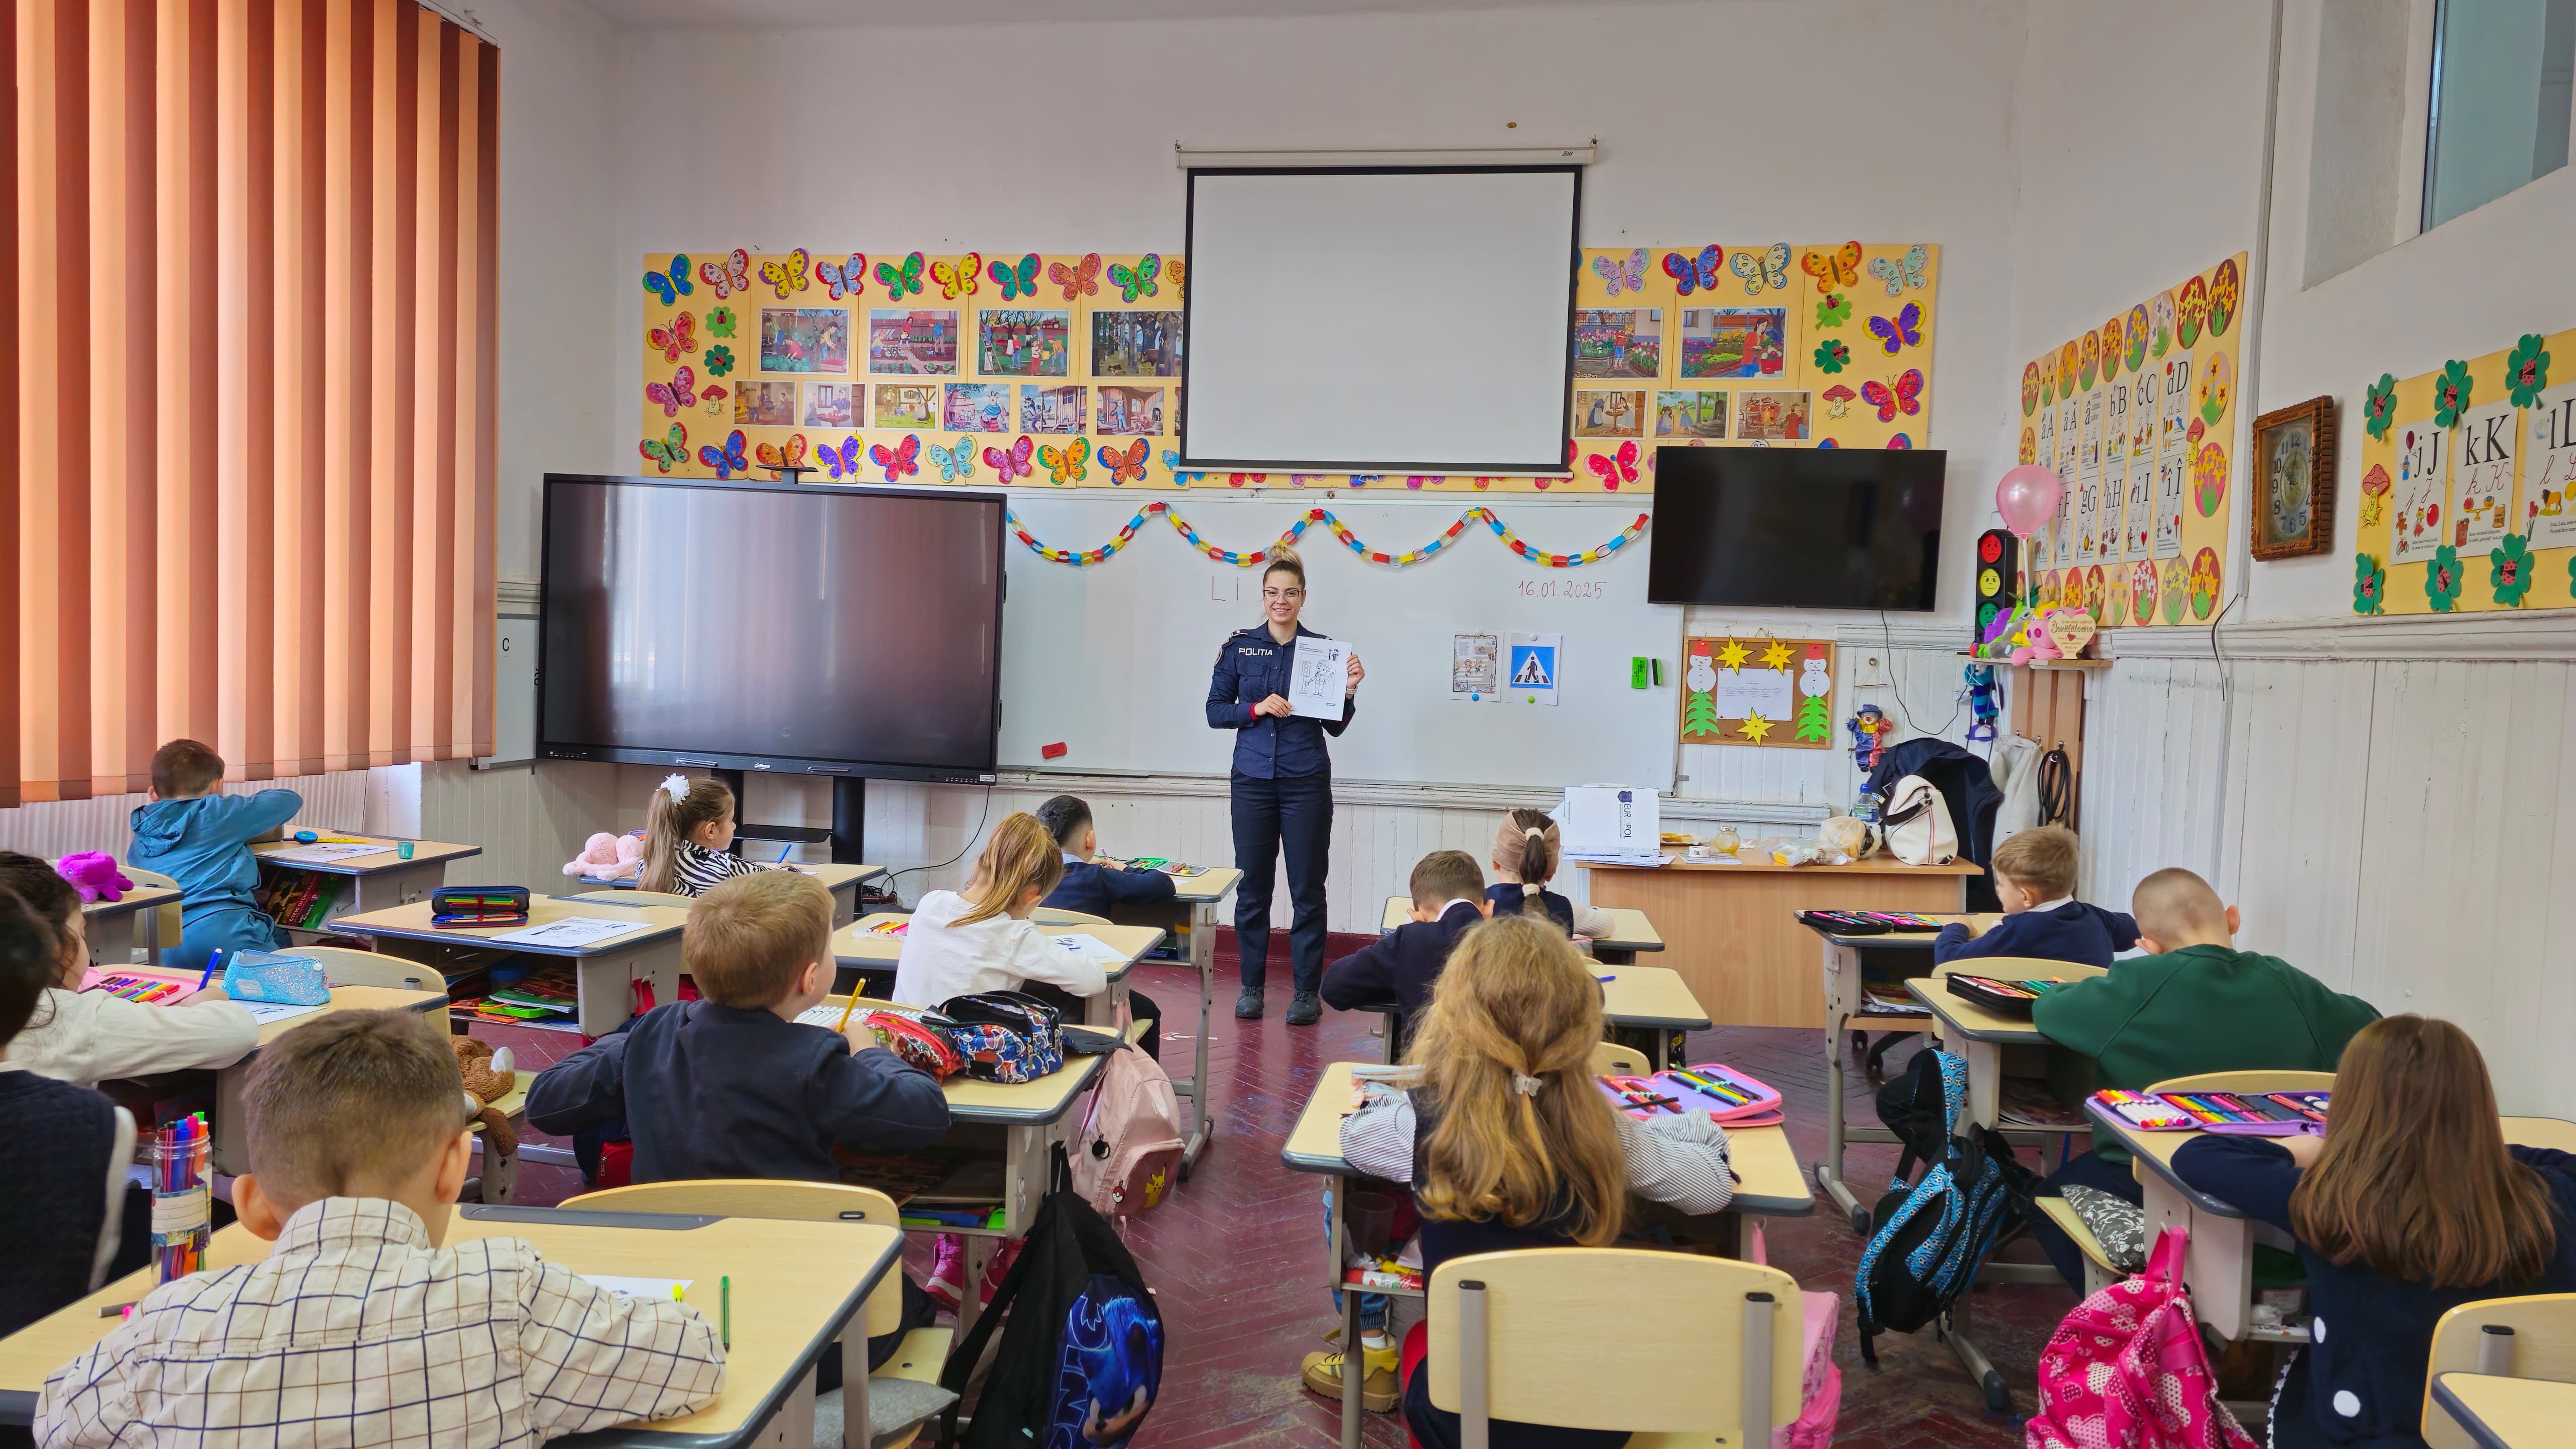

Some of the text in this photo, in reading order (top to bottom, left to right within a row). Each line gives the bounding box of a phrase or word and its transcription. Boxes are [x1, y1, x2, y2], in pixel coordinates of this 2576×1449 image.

[2282, 441, 2288, 454] 11
[2291, 434, 2300, 447] 12
[2464, 414, 2510, 467] kK
[2413, 431, 2442, 478] jJ
[2274, 458, 2282, 473] 10
[2273, 479, 2278, 494] 9
[2274, 500, 2280, 515] 8
[2281, 515, 2287, 530] 7
[2290, 517, 2296, 533] 6
[2299, 509, 2306, 526] 5
[1518, 580, 1607, 598] 16.01.2025
[503, 638, 509, 651] C
[1239, 648, 1273, 656] POLITIA
[1624, 804, 1632, 839] EUROPOL
